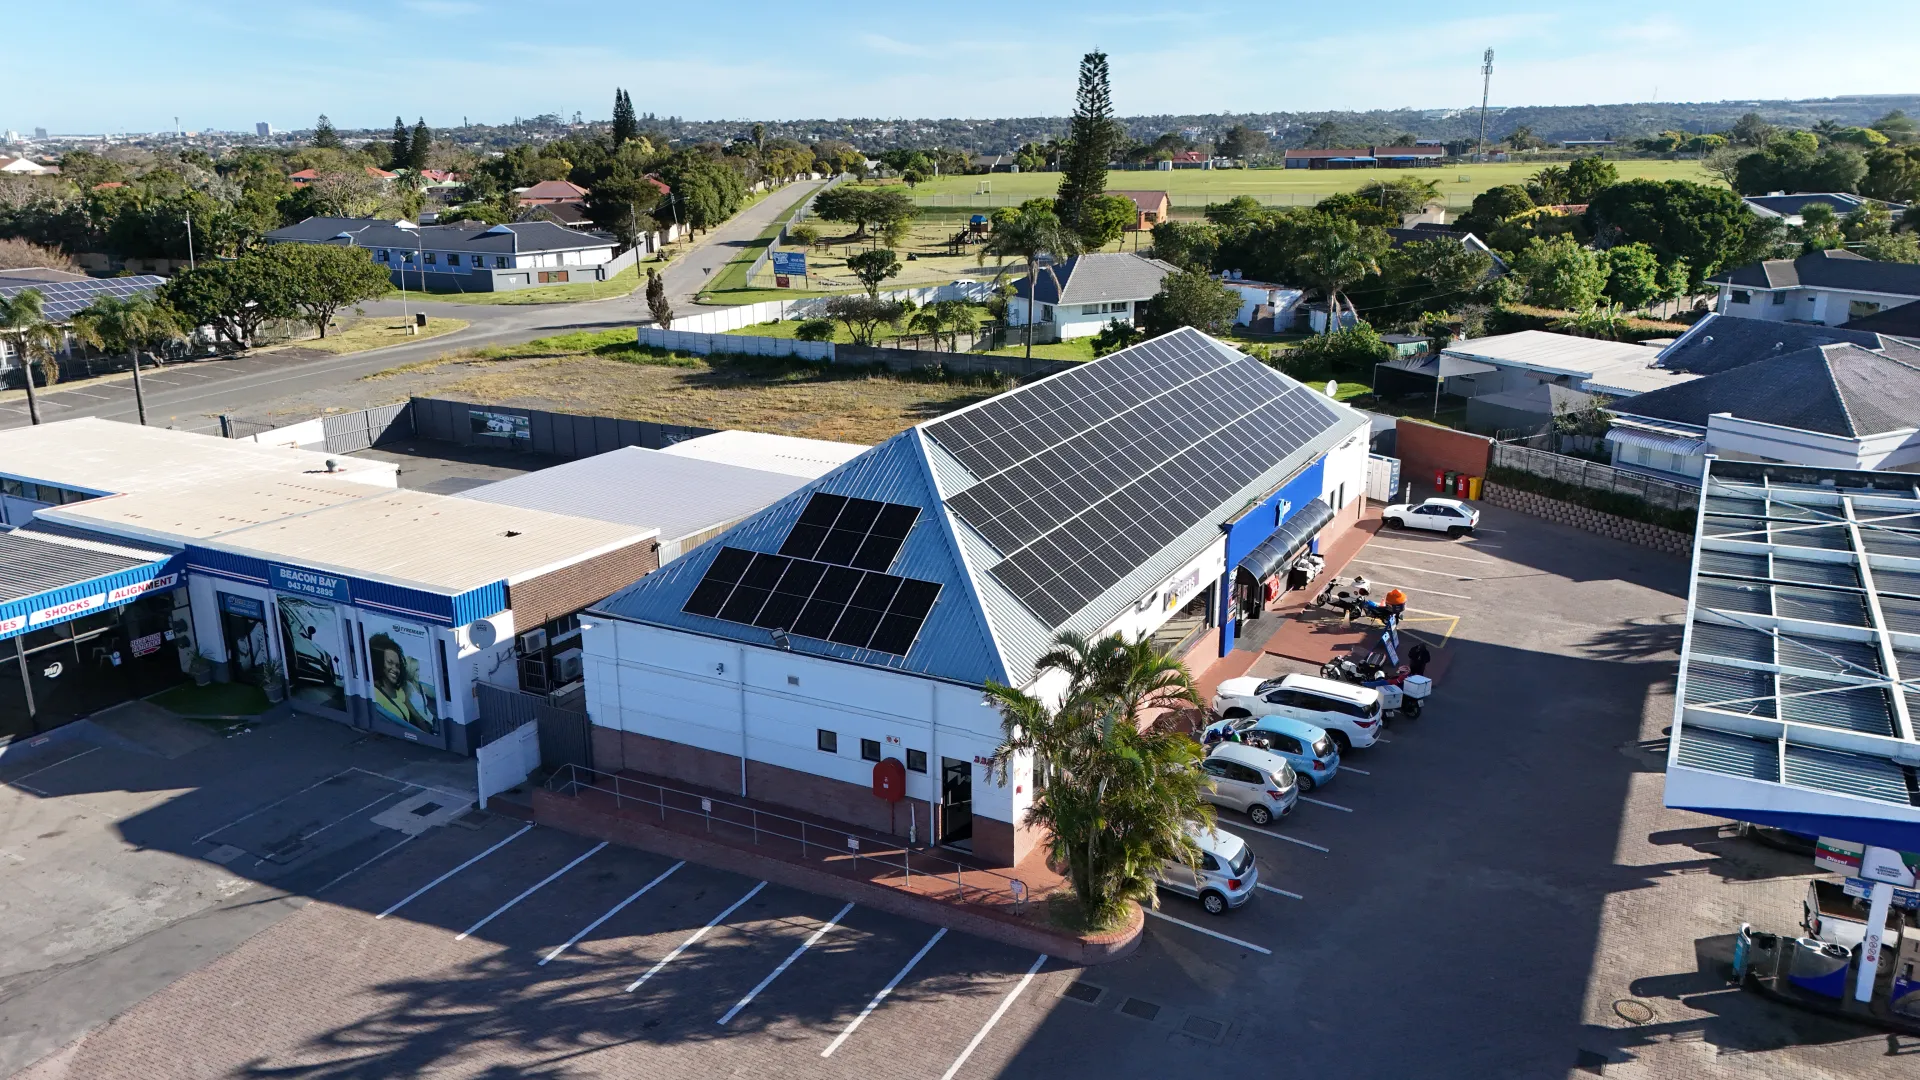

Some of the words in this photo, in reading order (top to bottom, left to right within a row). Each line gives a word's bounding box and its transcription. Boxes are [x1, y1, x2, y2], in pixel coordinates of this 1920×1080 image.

[279, 568, 317, 585] BEACON
[318, 577, 338, 588] BAY
[287, 580, 301, 590] 043
[114, 576, 173, 599] ALIGNMENT
[44, 599, 90, 619] SHOCKS
[400, 626, 425, 636] TYREMART
[1826, 855, 1848, 865] Diesel
